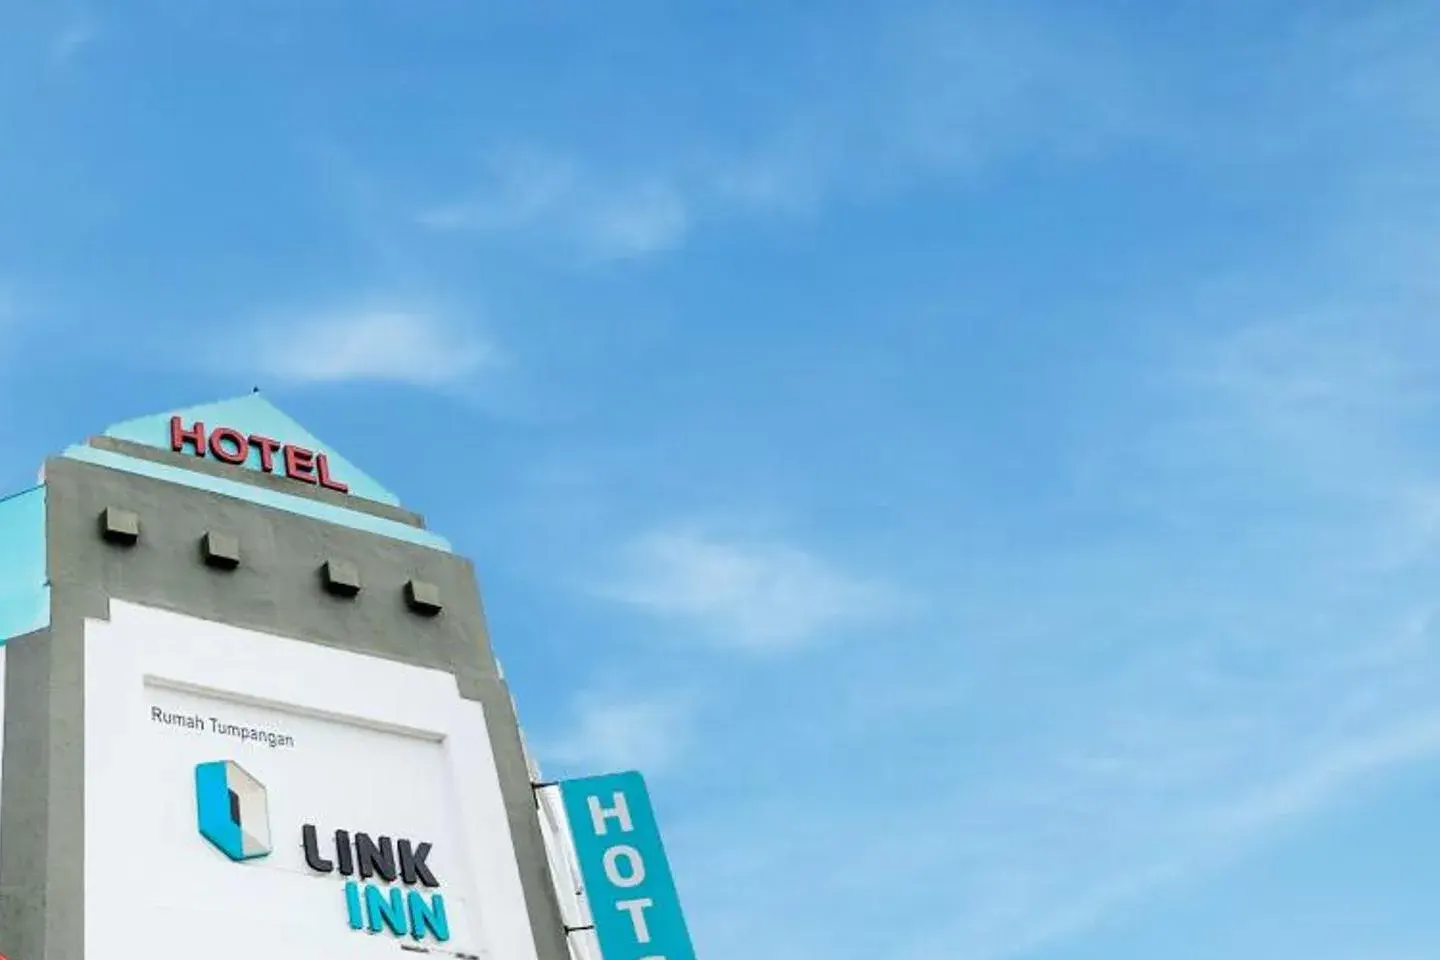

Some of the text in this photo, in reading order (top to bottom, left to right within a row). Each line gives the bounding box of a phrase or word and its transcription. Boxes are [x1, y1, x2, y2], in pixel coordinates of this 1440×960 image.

[169, 415, 348, 493] HOTEL
[151, 705, 294, 748] Rumah Tumpangan
[302, 824, 440, 888] LINK
[345, 881, 450, 942] INN
